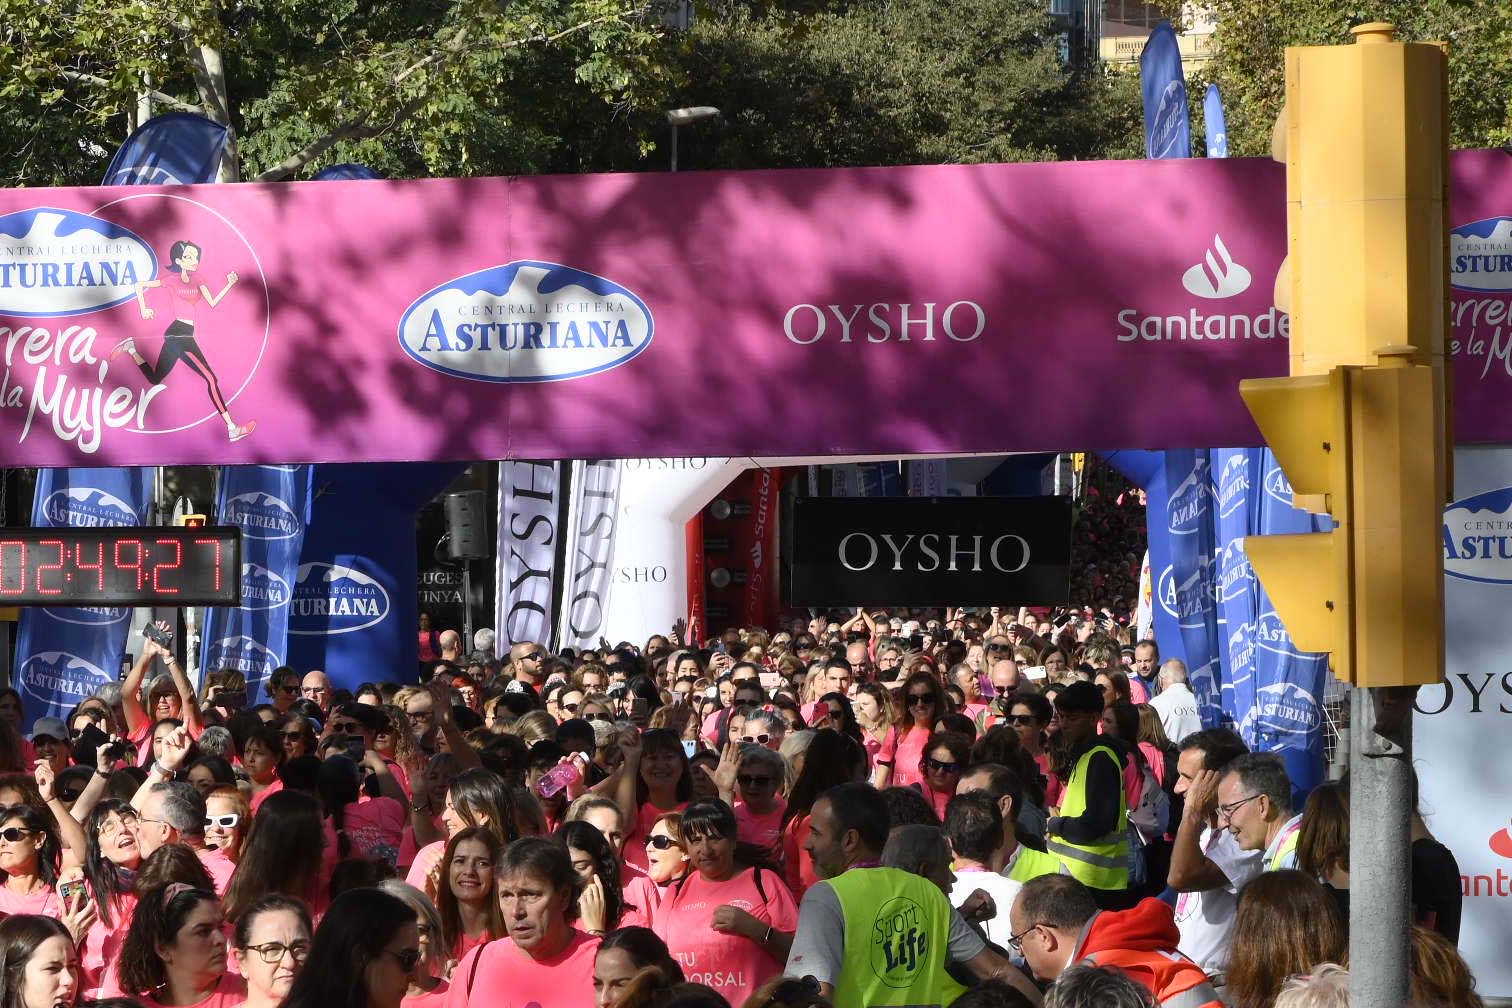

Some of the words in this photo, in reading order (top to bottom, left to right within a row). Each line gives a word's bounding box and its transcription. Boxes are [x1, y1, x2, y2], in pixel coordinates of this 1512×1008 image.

[60, 244, 133, 255] LECHERA
[1457, 243, 1508, 251] CENTRAL
[1451, 254, 1512, 273] STUR
[458, 303, 536, 316] CENTRAL
[544, 301, 626, 314] LECHERA
[783, 300, 986, 345] OYSHO
[418, 308, 634, 353] ASTURIANA
[1116, 307, 1289, 342] Santande
[1467, 328, 1485, 355] la
[0, 369, 24, 409] la
[19, 360, 168, 454] Mujer
[225, 505, 292, 534] ASTURIANA
[506, 460, 555, 646] OYSH
[569, 459, 615, 640] OYSH
[838, 532, 1031, 573] OYSHO
[610, 566, 667, 584] YSHO
[241, 584, 283, 602] URIANA
[328, 586, 376, 596] LECHERA
[289, 597, 380, 617] TURIANA
[26, 664, 99, 697] ASTURIAN
[678, 951, 696, 968] TU
[882, 927, 928, 974] Life
